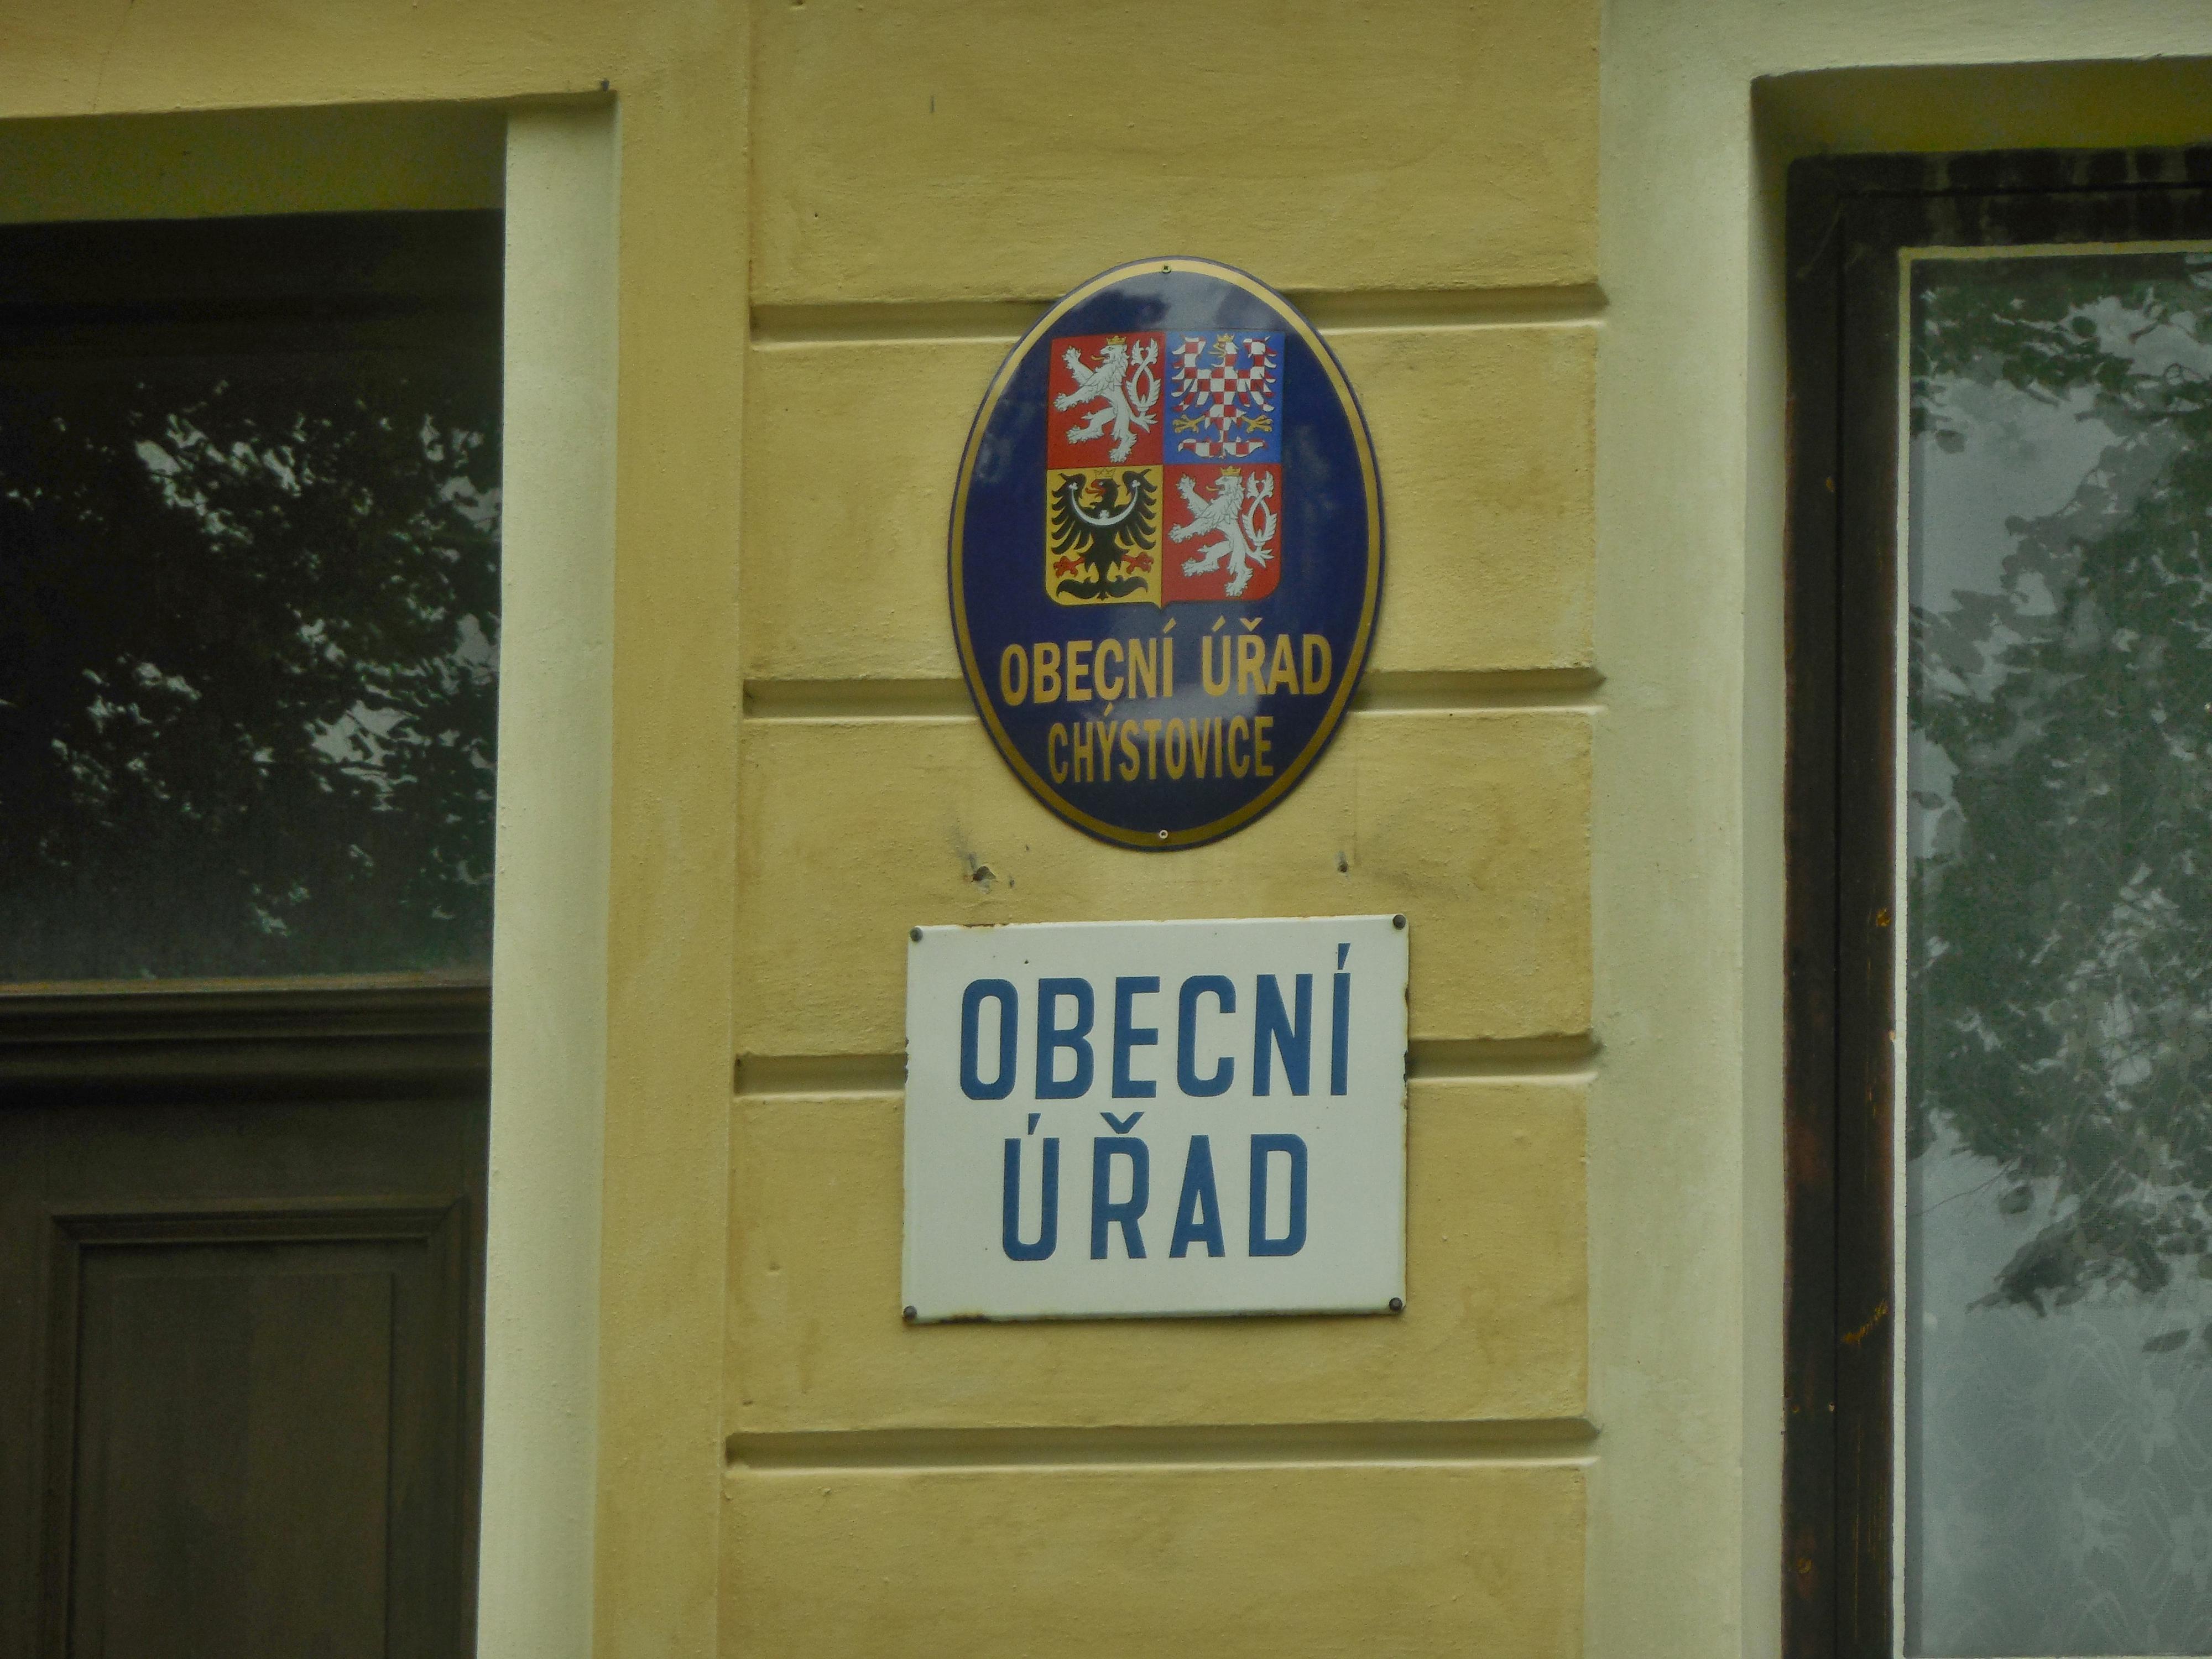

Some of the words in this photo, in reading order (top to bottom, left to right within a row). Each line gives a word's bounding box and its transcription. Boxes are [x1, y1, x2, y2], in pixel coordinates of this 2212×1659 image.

[1000, 618, 1176, 707] OBECNÍ
[1201, 616, 1333, 697] ÚŘAD
[1047, 702, 1275, 785] CHÝSTOVICE
[959, 942, 1352, 1100] OBECNÍ
[1001, 1111, 1308, 1262] ÚŘAD
